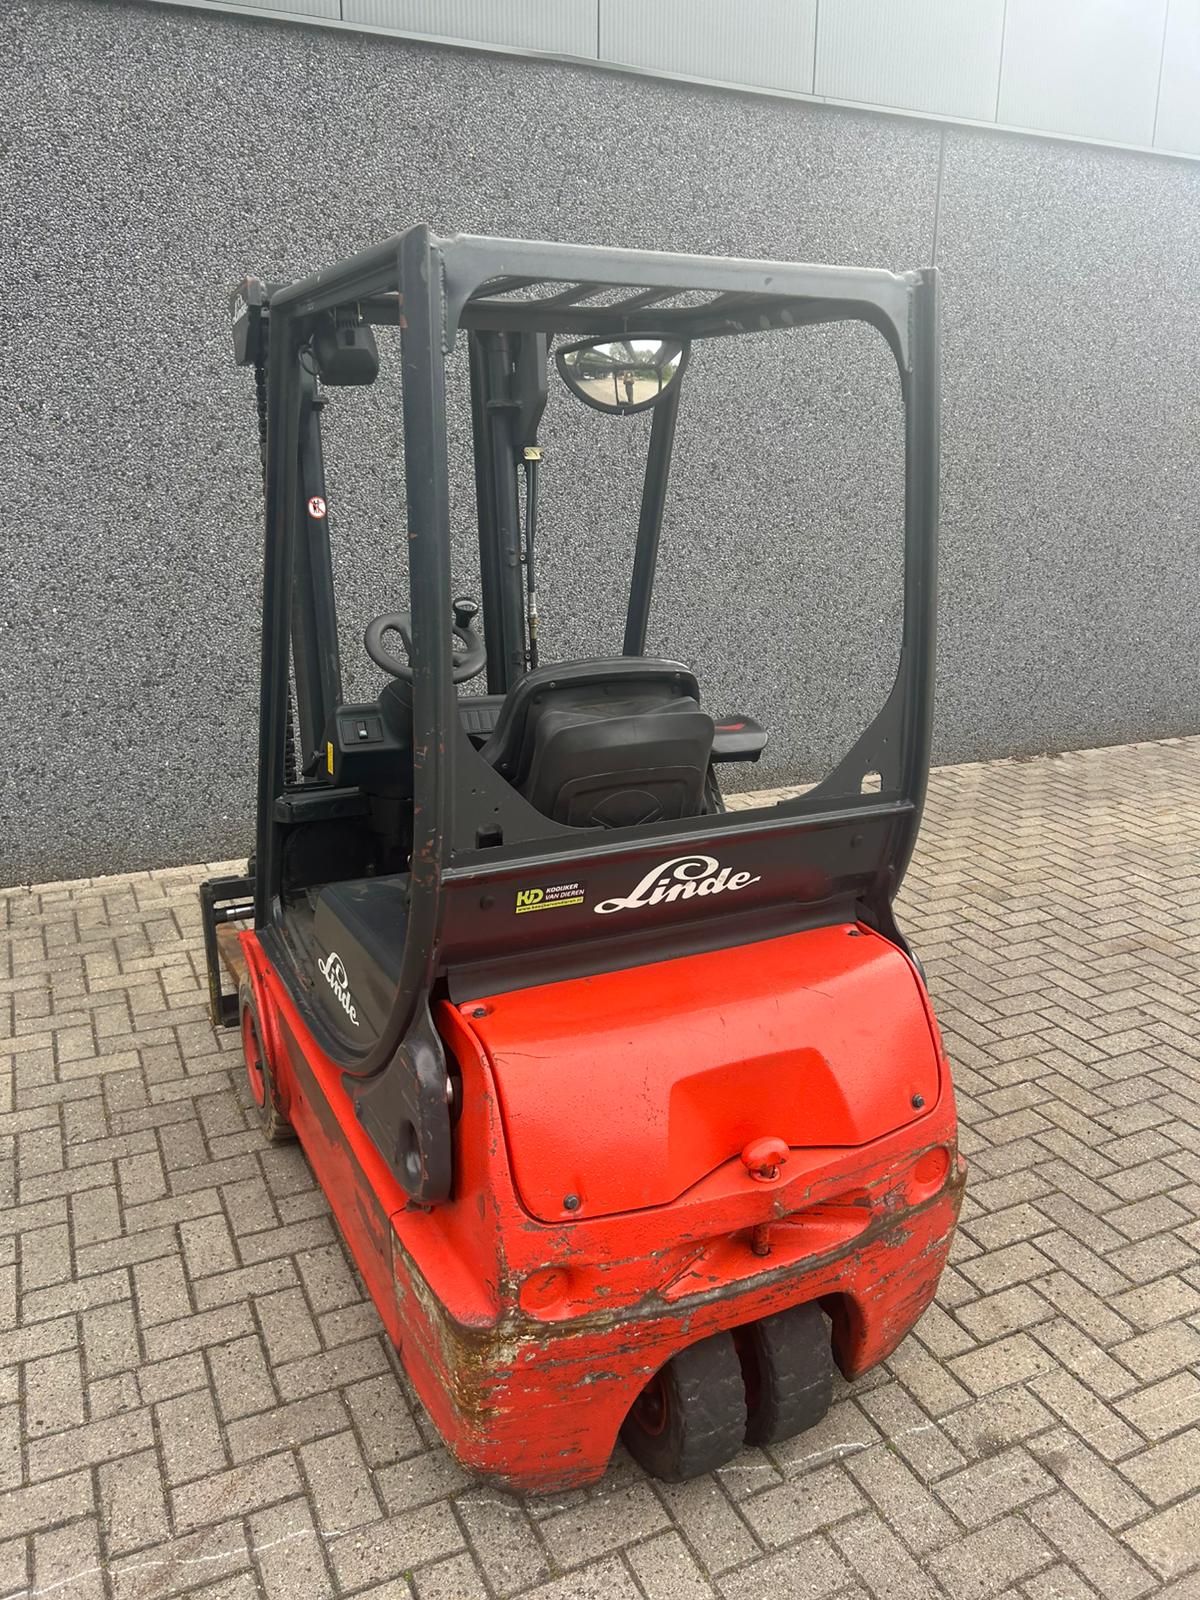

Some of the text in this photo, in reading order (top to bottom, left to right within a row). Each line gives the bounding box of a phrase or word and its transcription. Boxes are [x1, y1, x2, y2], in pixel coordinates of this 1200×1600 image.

[516, 889, 544, 906] KD
[560, 889, 585, 898] DIEREN
[594, 854, 761, 914] Linde
[318, 952, 360, 1027] Linde
